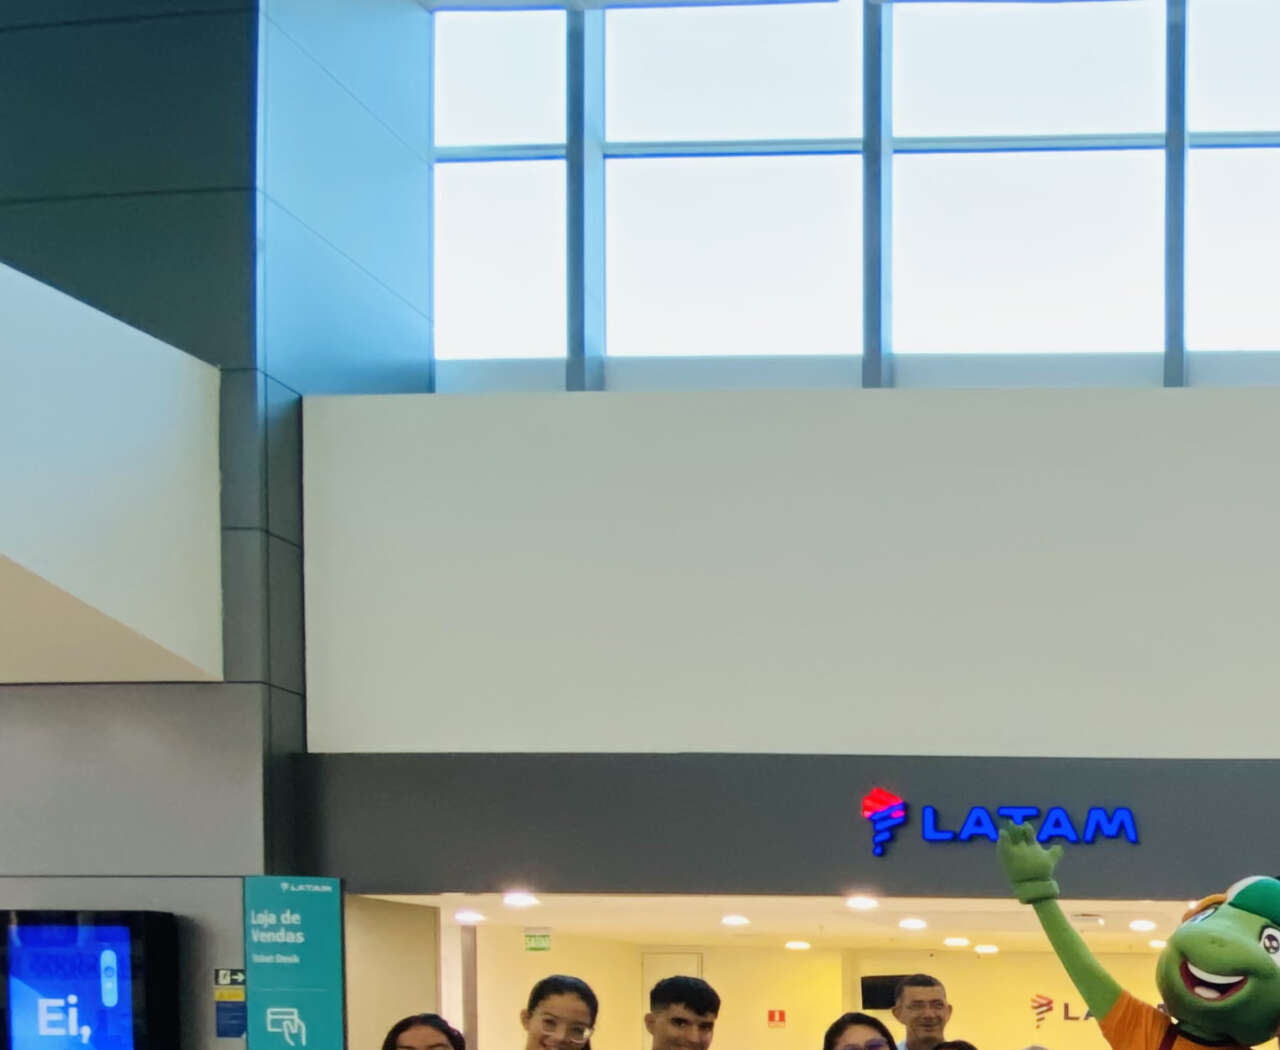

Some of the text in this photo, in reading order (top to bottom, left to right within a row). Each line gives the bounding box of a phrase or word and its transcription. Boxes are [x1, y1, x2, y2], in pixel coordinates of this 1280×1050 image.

[922, 805, 1139, 843] LATAM
[251, 909, 301, 928] Loja de
[251, 927, 305, 943] Vendas
[38, 994, 92, 1044] Ei,
